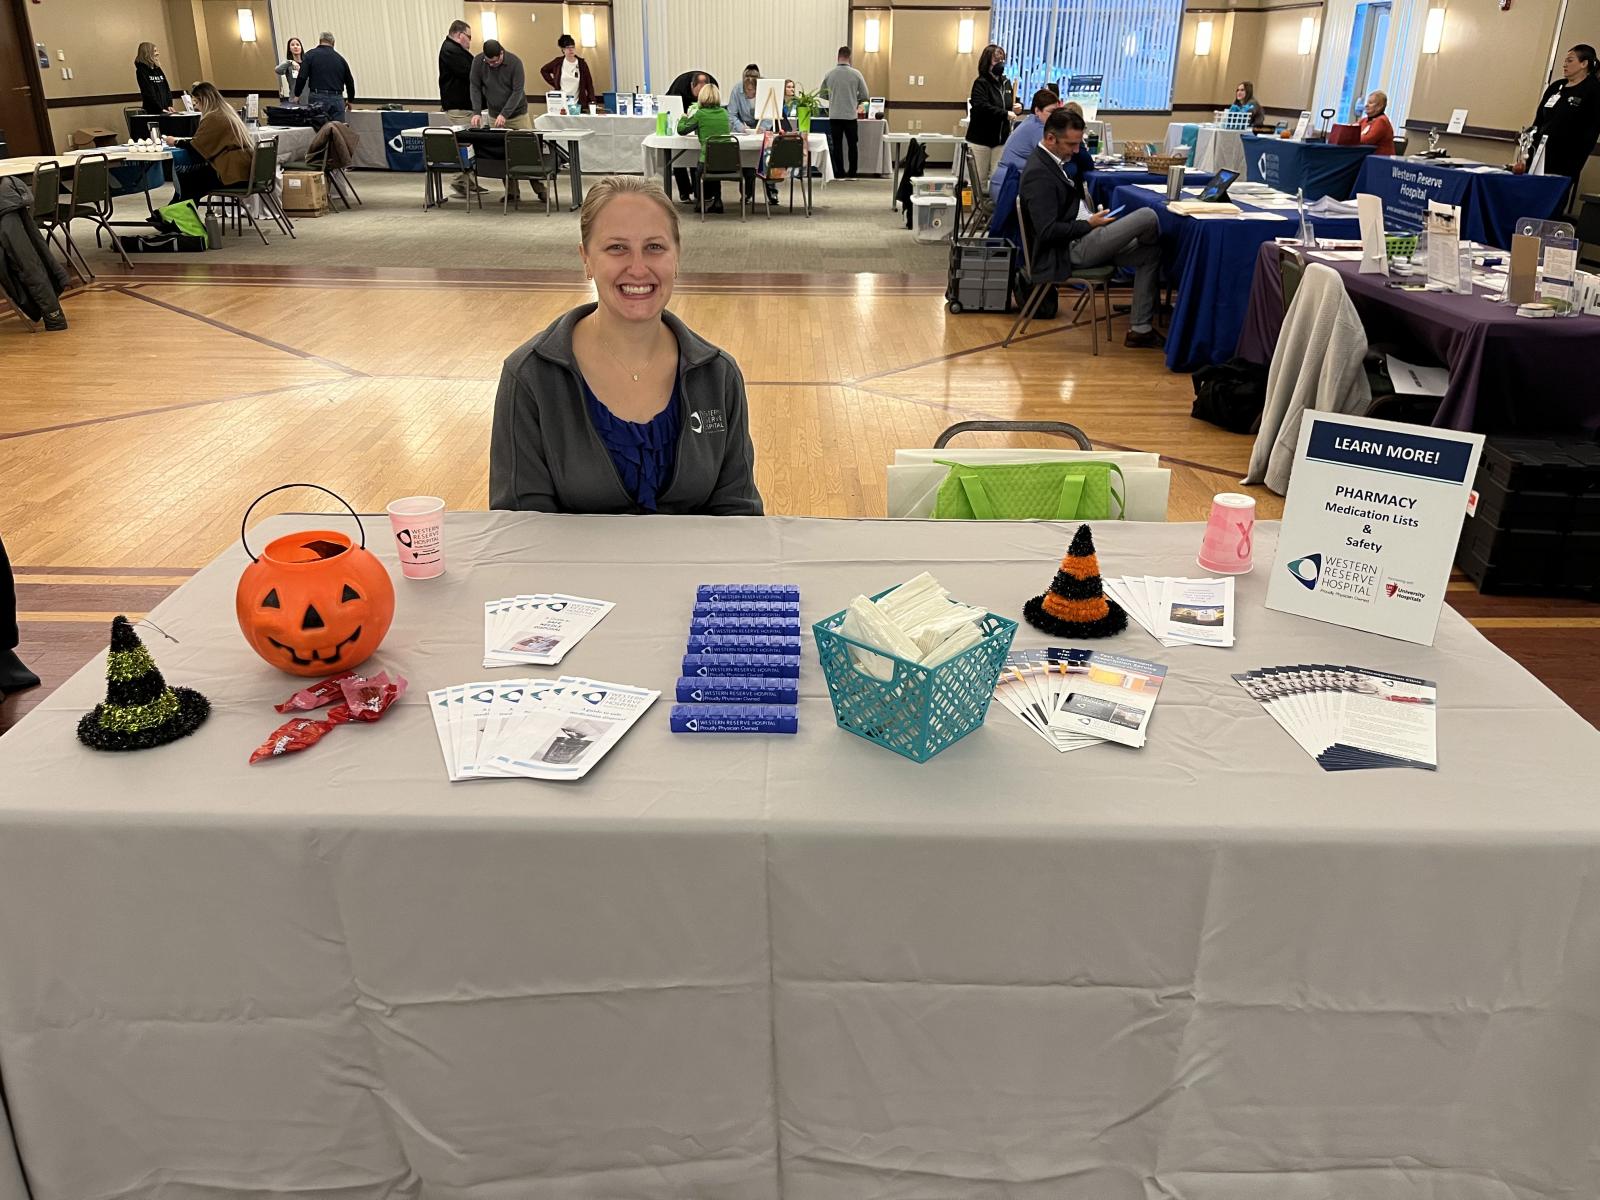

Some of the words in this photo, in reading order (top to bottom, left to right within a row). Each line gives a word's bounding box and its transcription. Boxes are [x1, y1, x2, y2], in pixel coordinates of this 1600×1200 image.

[1392, 166, 1416, 182] Western
[1417, 172, 1442, 188] Reserve
[1400, 184, 1427, 200] Hospital
[1334, 437, 1382, 455] LEARN
[1386, 444, 1440, 464] MORE!
[1335, 486, 1418, 510] PHARMACY
[1325, 502, 1390, 522] Medication
[1393, 515, 1418, 528] Lists
[412, 526, 439, 534] WESTERN
[413, 531, 439, 539] RESERVE
[1362, 524, 1372, 534] &
[1346, 536, 1382, 553] Safety
[1326, 556, 1378, 575] WESTERN
[1324, 567, 1374, 586] RESERVE
[1322, 578, 1371, 596] HOSPITAL
[1398, 588, 1426, 598] University
[1397, 593, 1421, 602] Hospitals
